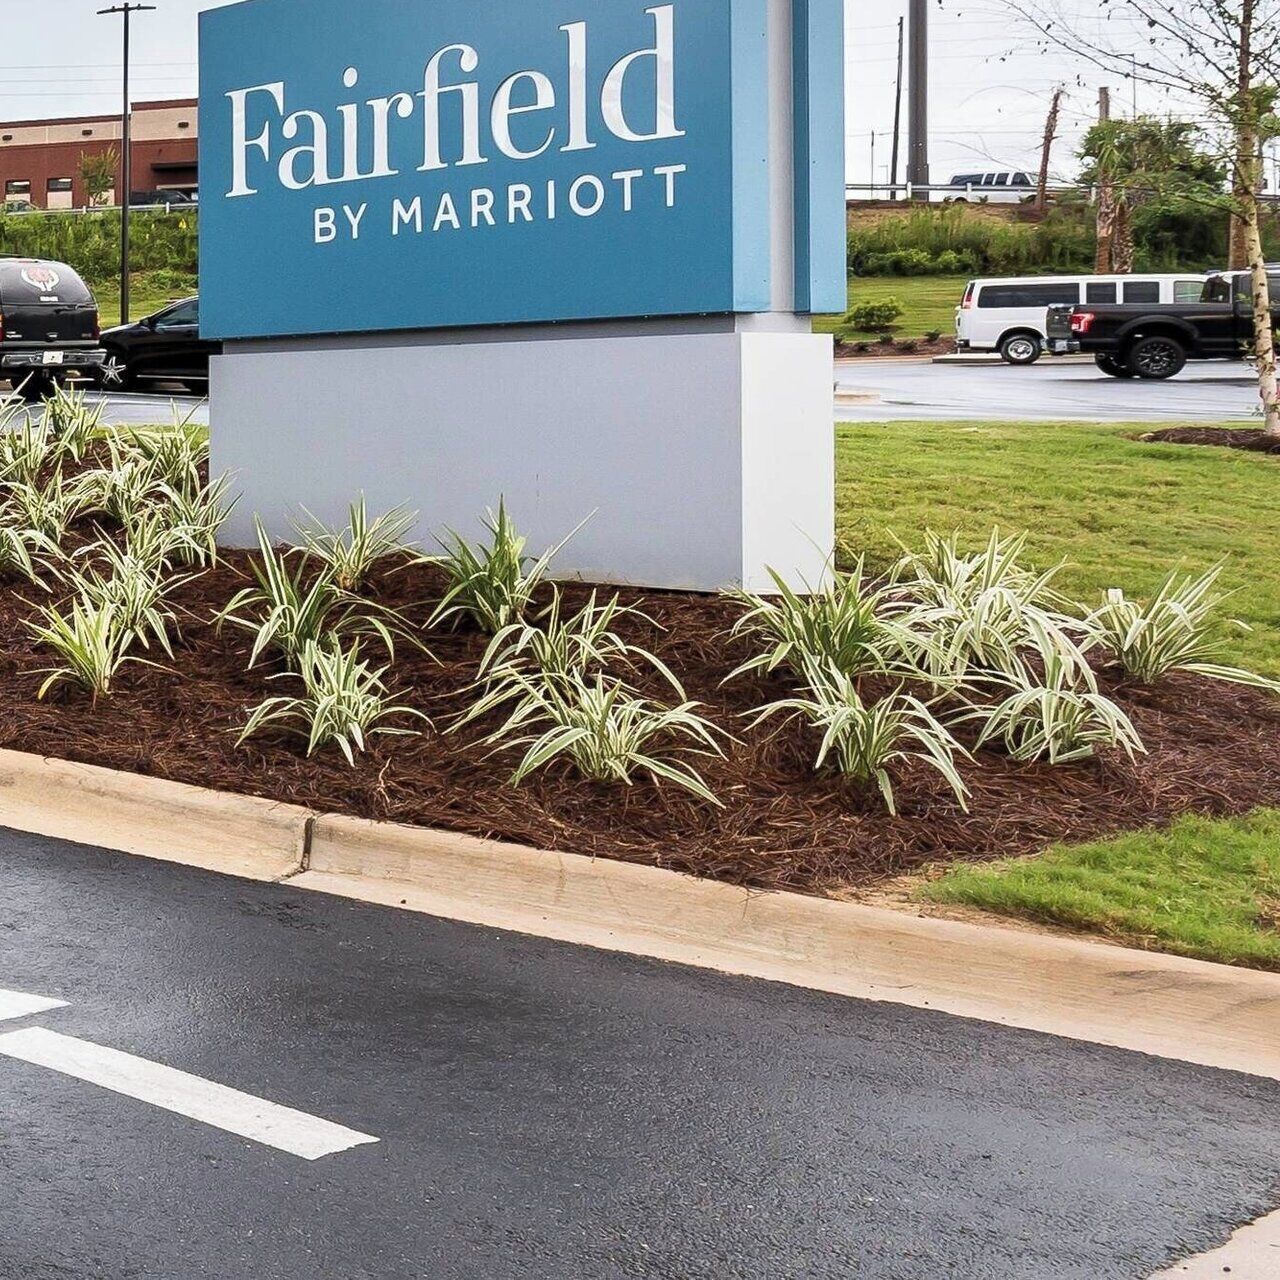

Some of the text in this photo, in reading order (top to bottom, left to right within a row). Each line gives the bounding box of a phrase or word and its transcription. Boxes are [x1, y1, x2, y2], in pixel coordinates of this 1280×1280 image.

[224, 4, 686, 198] Fairfield
[314, 164, 686, 243] BY MARRIOTT
